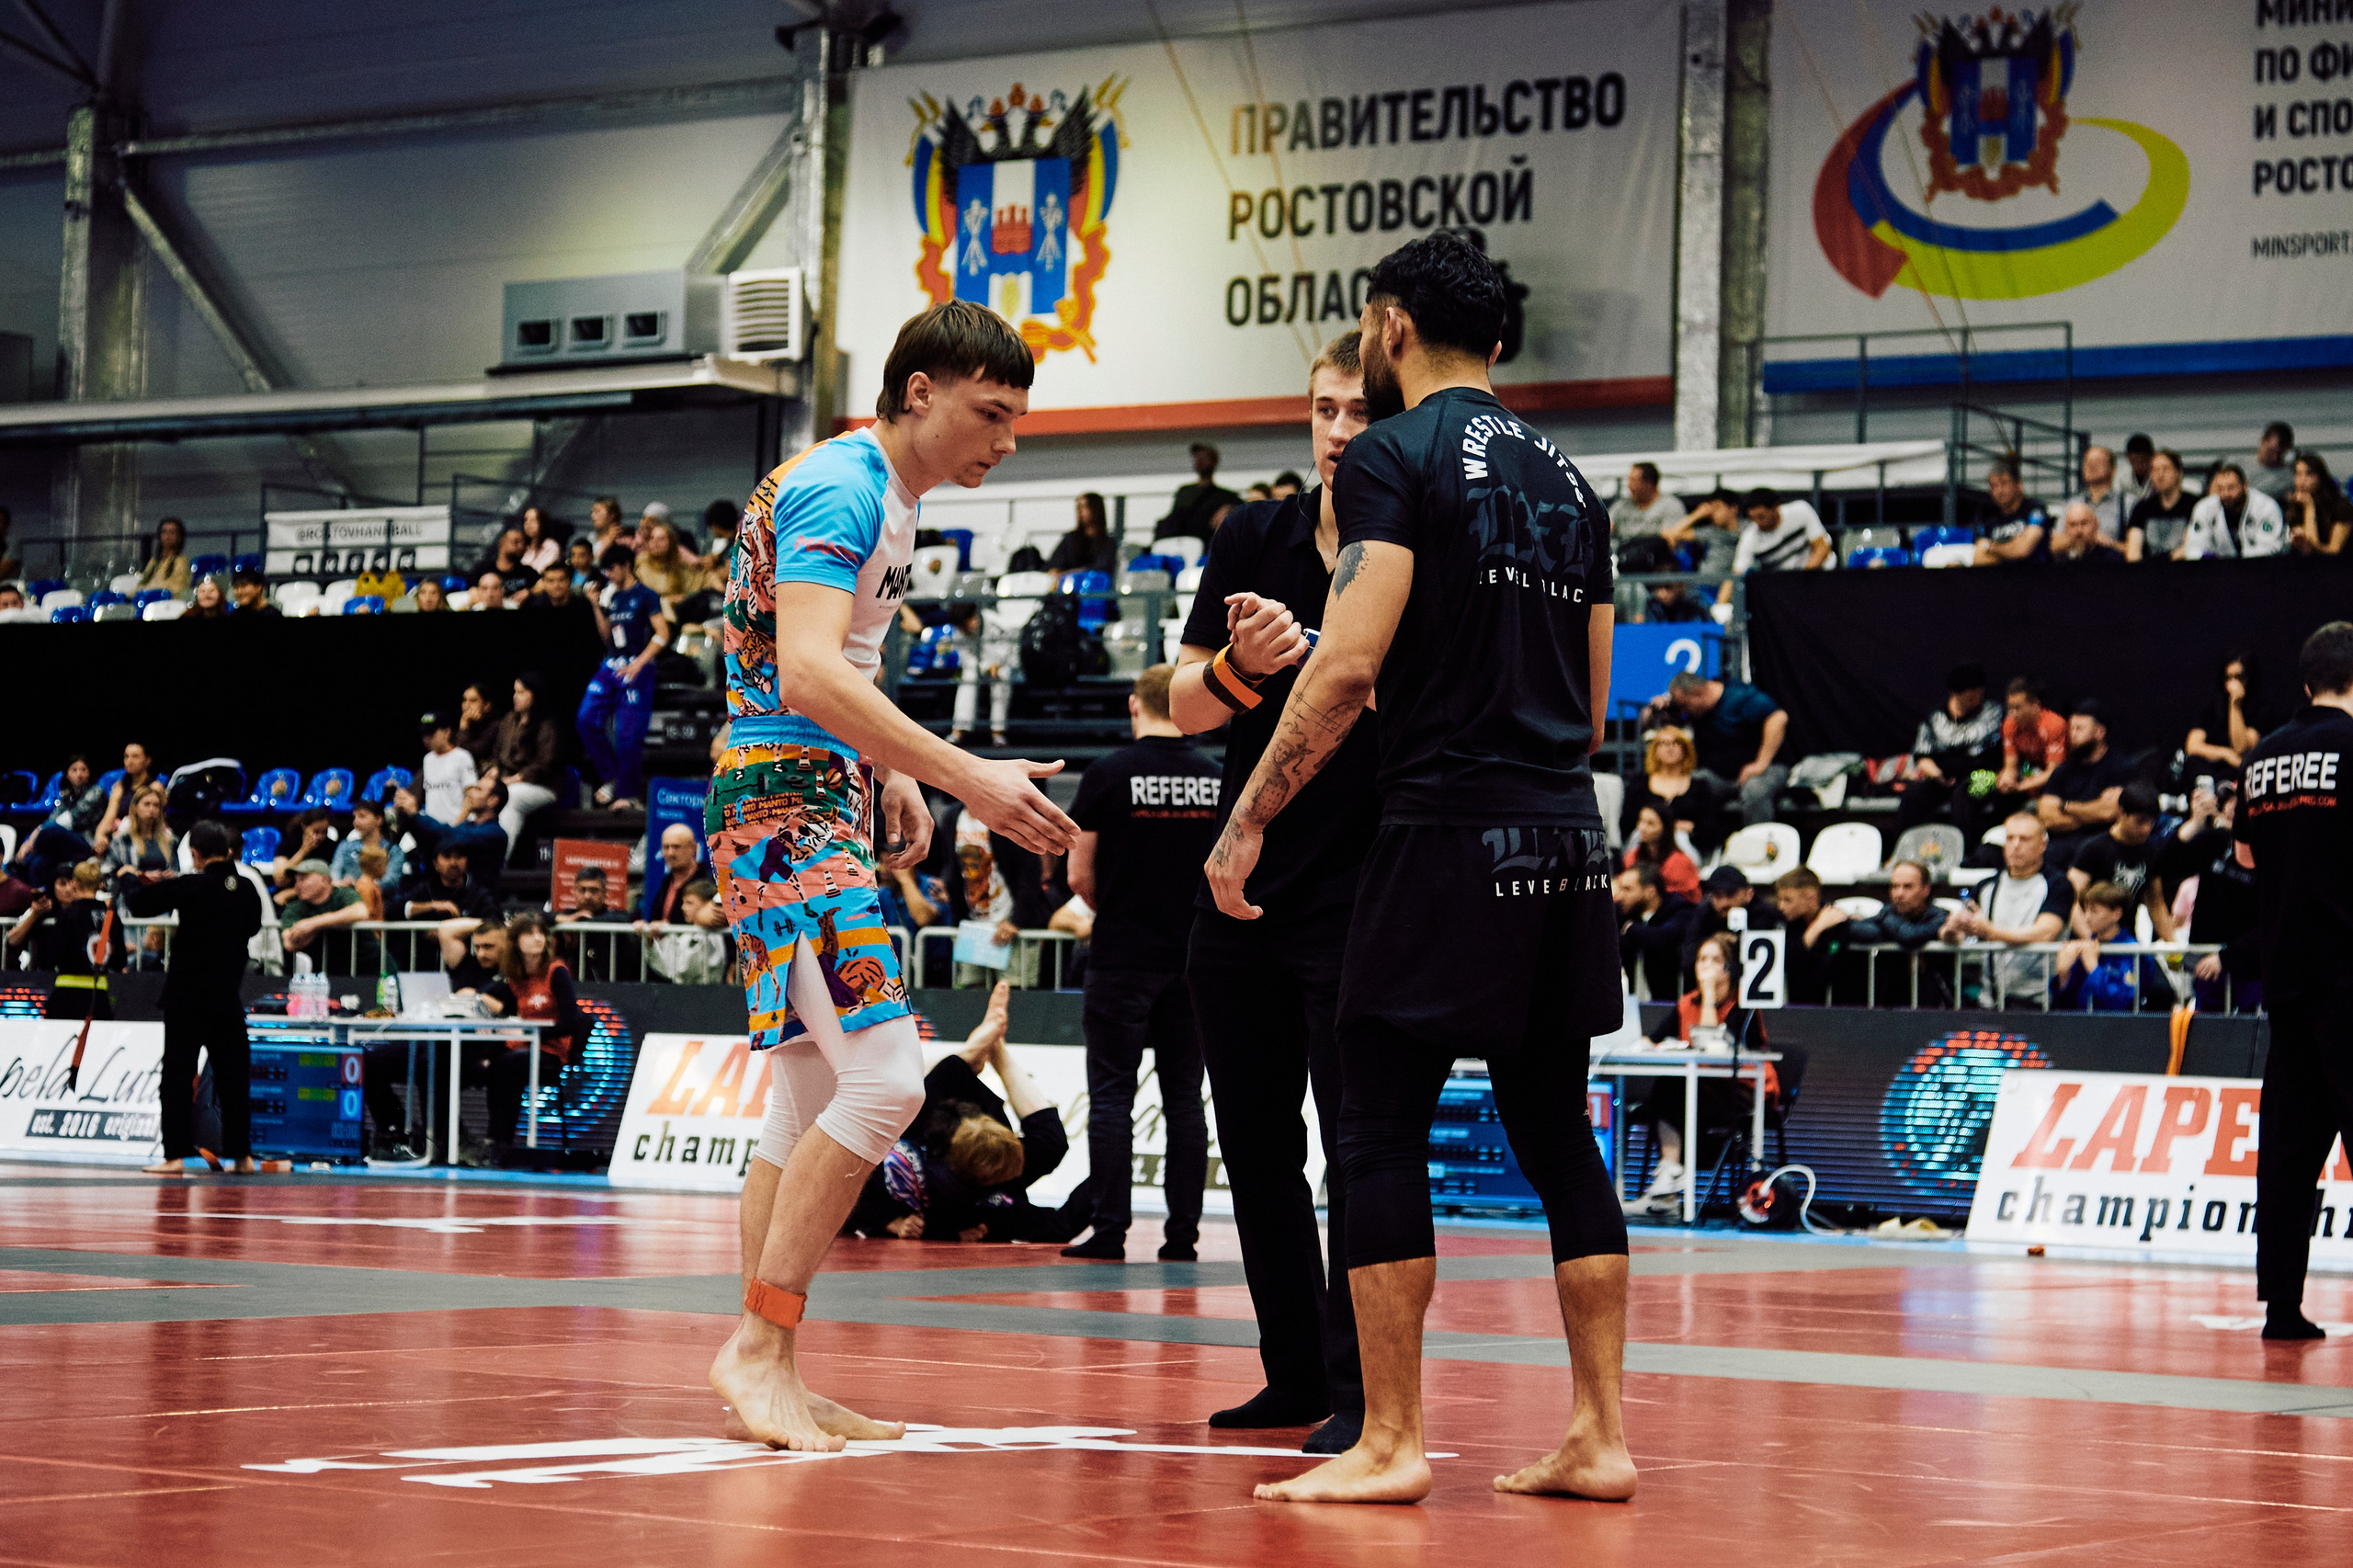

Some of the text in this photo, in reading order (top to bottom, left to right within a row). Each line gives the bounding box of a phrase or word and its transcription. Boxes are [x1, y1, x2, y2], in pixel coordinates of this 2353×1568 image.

[2255, 46, 2300, 85] ПО
[1230, 72, 1626, 155] ПРАВИТЕЛЬСТВО
[2254, 98, 2353, 141] И СПО
[2253, 154, 2353, 196] РОСТО
[1229, 153, 1533, 241] РОСТОВСКОЙ
[1226, 267, 1372, 326] ОБЛАС
[1462, 415, 1525, 480] WRESTLE
[296, 524, 424, 542] @ROTOVHANBALL
[876, 562, 913, 600] MANT
[2245, 751, 2340, 801] REFEREE
[758, 797, 788, 809] MANTO
[1495, 880, 1550, 897] LEVE
[1747, 938, 1775, 1000] 2
[345, 1056, 358, 1084] 0
[2010, 1084, 2261, 1177] LAPE
